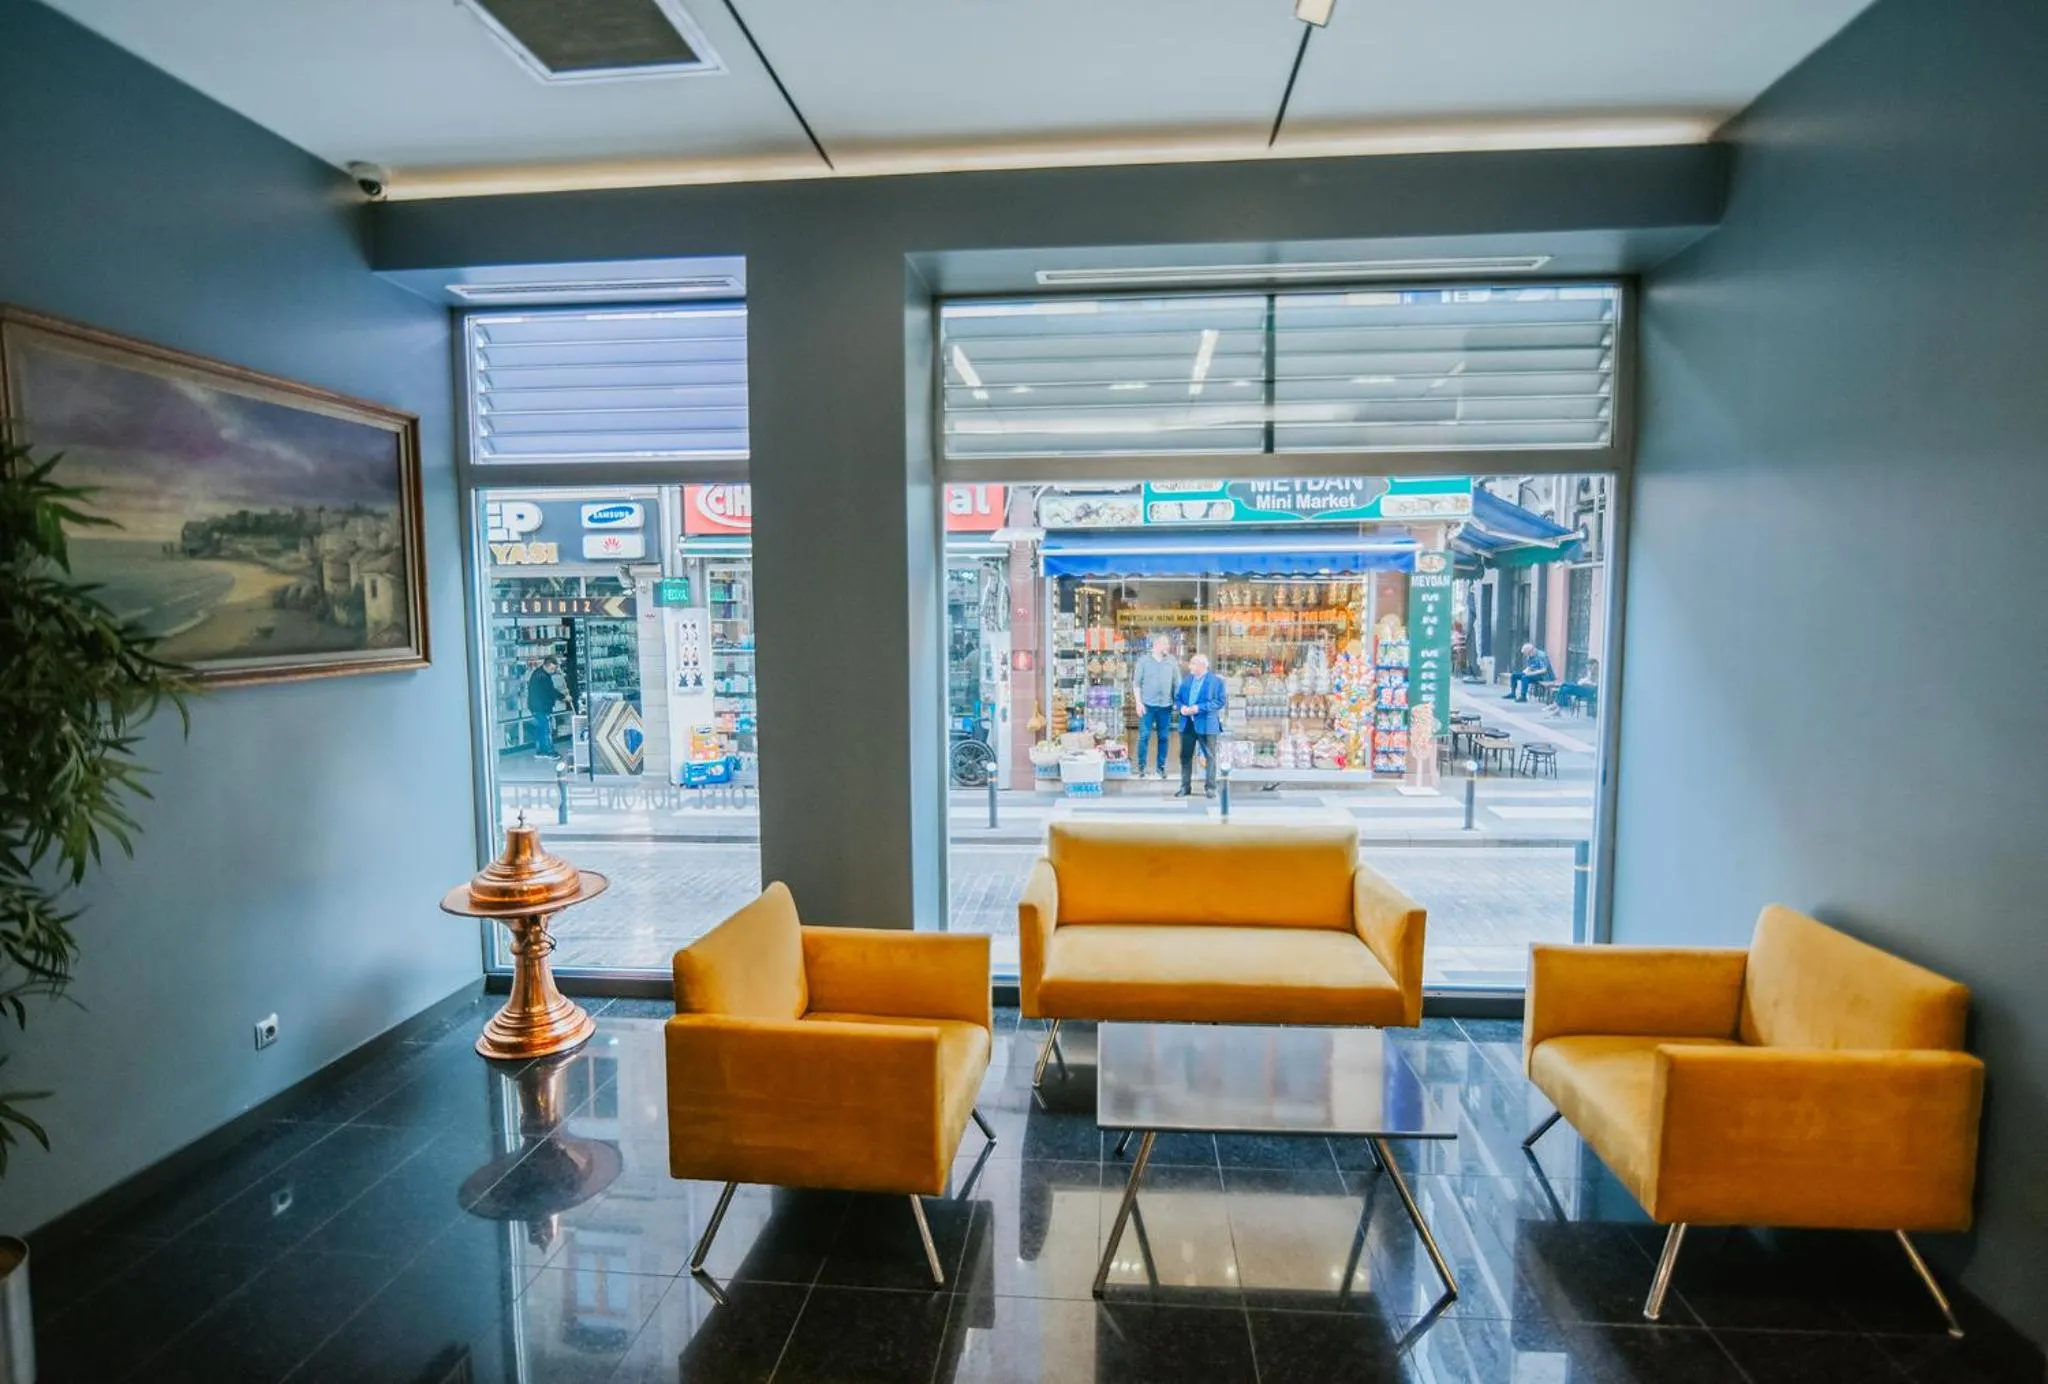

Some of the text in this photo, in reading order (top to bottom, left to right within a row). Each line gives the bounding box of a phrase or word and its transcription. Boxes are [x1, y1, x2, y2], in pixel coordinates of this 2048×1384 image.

[1256, 492, 1356, 510] Mini Market
[592, 510, 631, 520] SAMSUNG
[1411, 575, 1451, 587] MEYDAN
